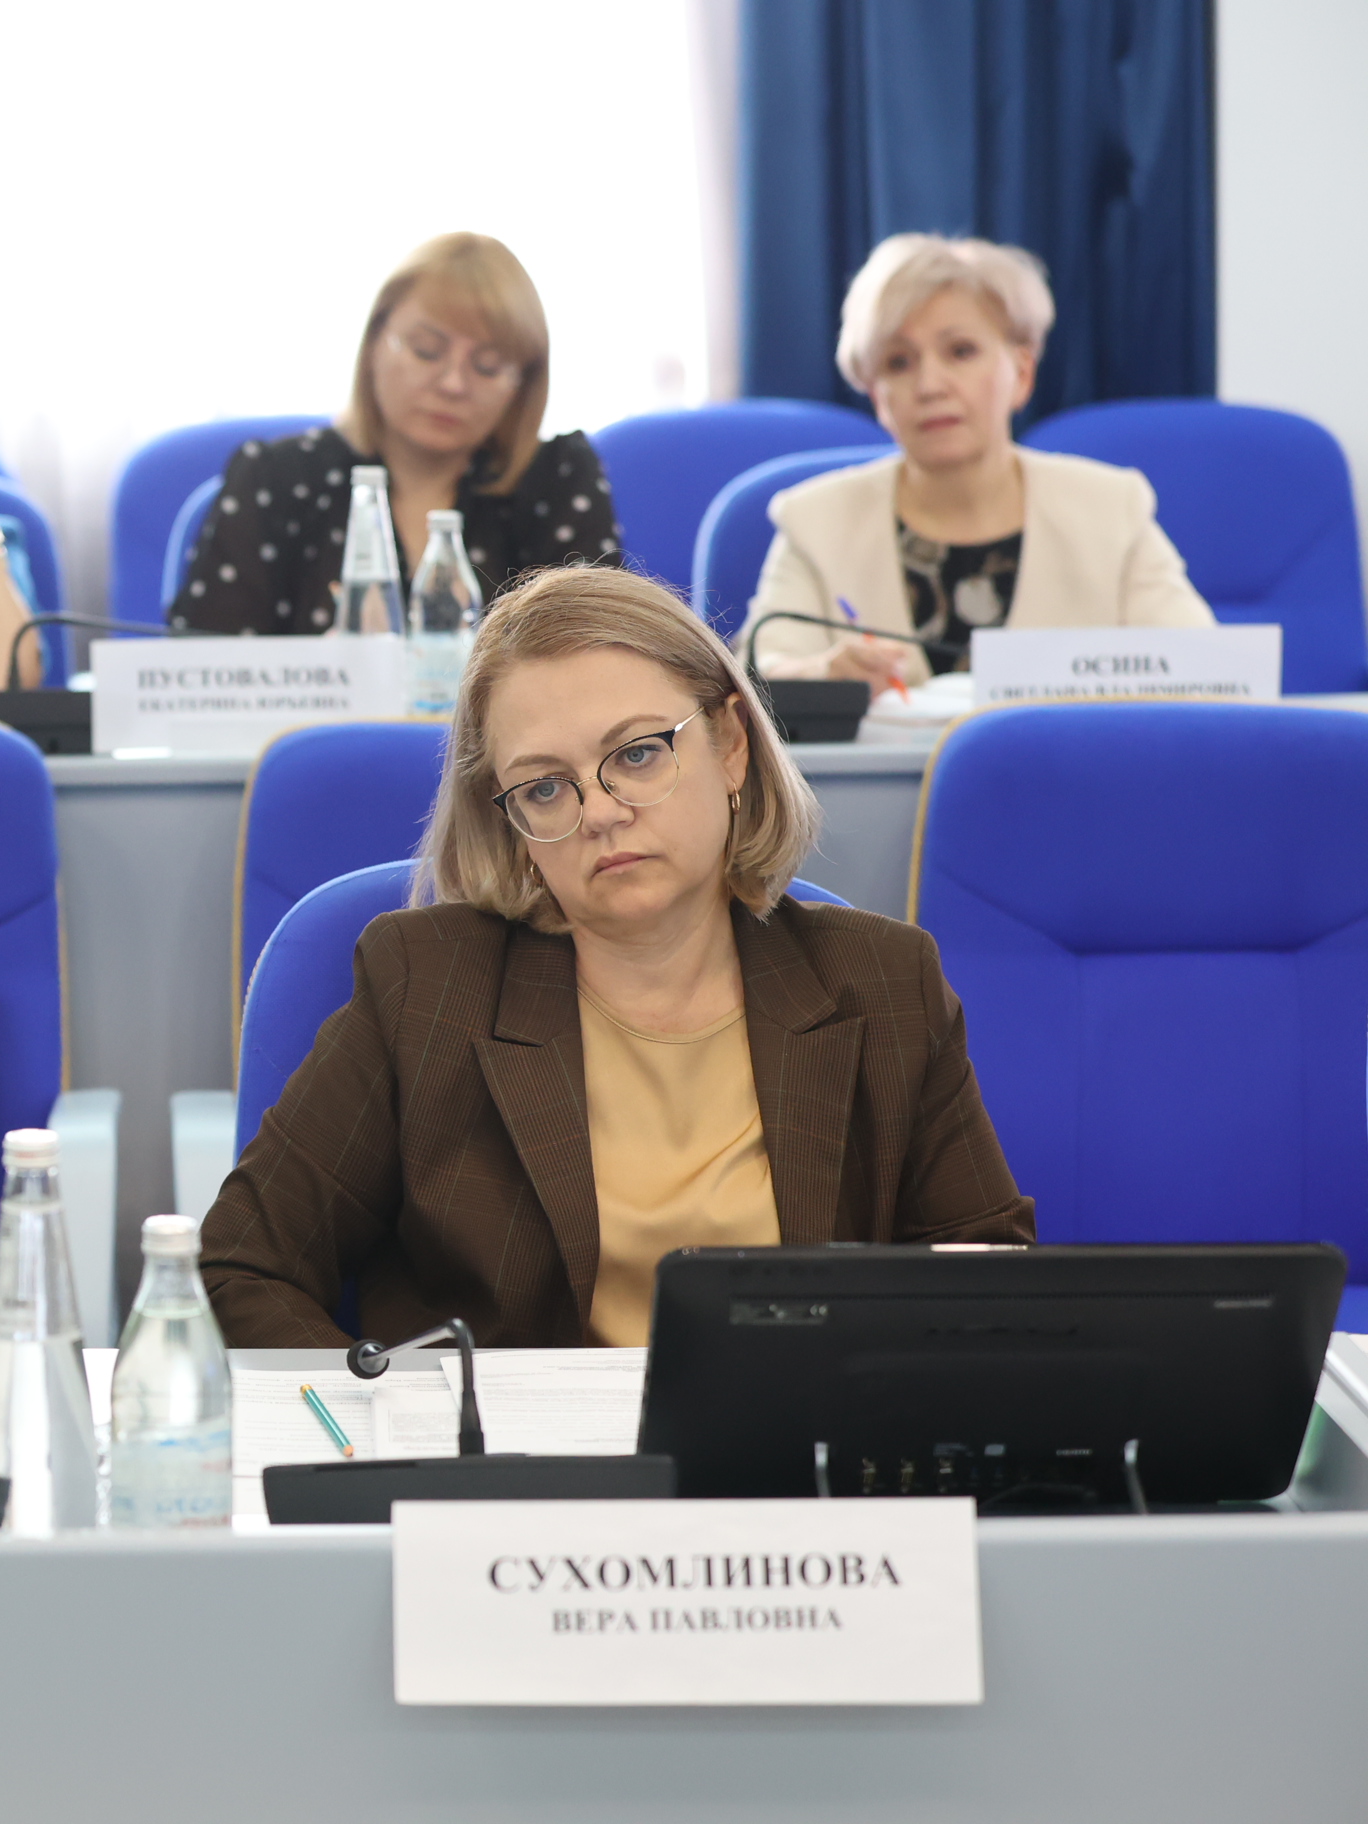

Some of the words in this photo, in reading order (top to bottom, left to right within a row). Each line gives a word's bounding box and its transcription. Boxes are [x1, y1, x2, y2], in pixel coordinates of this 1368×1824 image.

[137, 666, 350, 690] ПУСТОВАЛОВА
[1071, 655, 1171, 676] ОСИНА
[488, 1552, 902, 1593] СУХОМЛИНОВА
[552, 1608, 639, 1634] ВЕРА
[650, 1605, 844, 1632] ПАВЛОВНА
